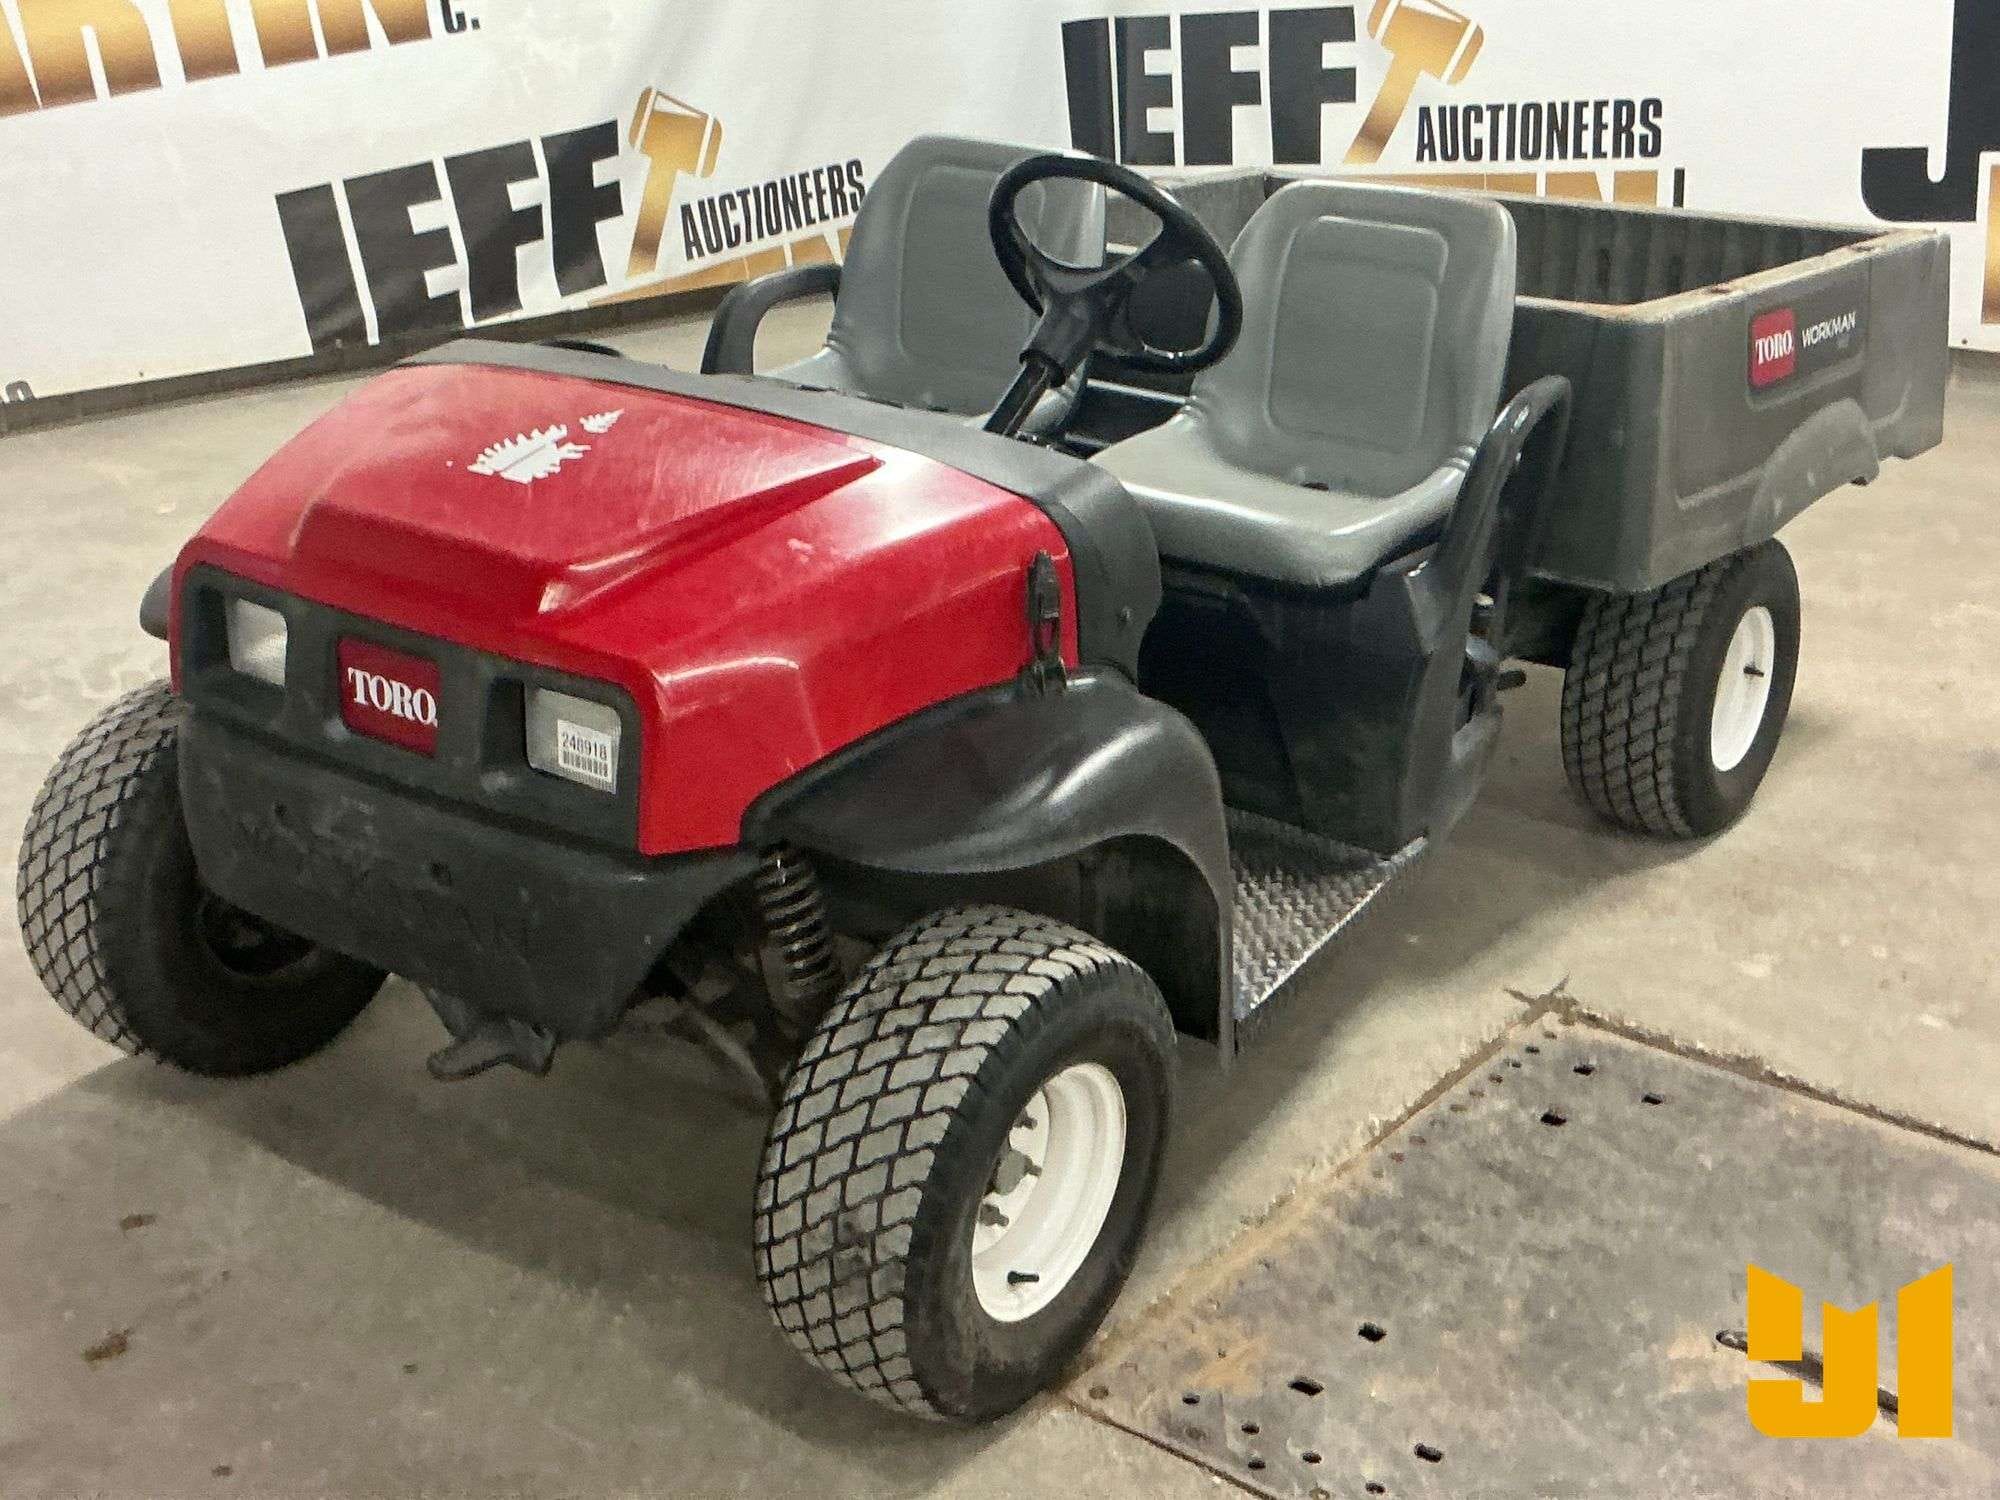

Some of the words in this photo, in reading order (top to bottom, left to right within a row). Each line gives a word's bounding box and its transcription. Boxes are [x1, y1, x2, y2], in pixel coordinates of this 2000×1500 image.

[1416, 97, 1663, 163] AUCTIONEERS
[680, 158, 867, 262] AUCTIONEERS
[1756, 329, 1794, 365] TORO
[1801, 311, 1856, 349] WORKMAN
[347, 667, 438, 728] TORO
